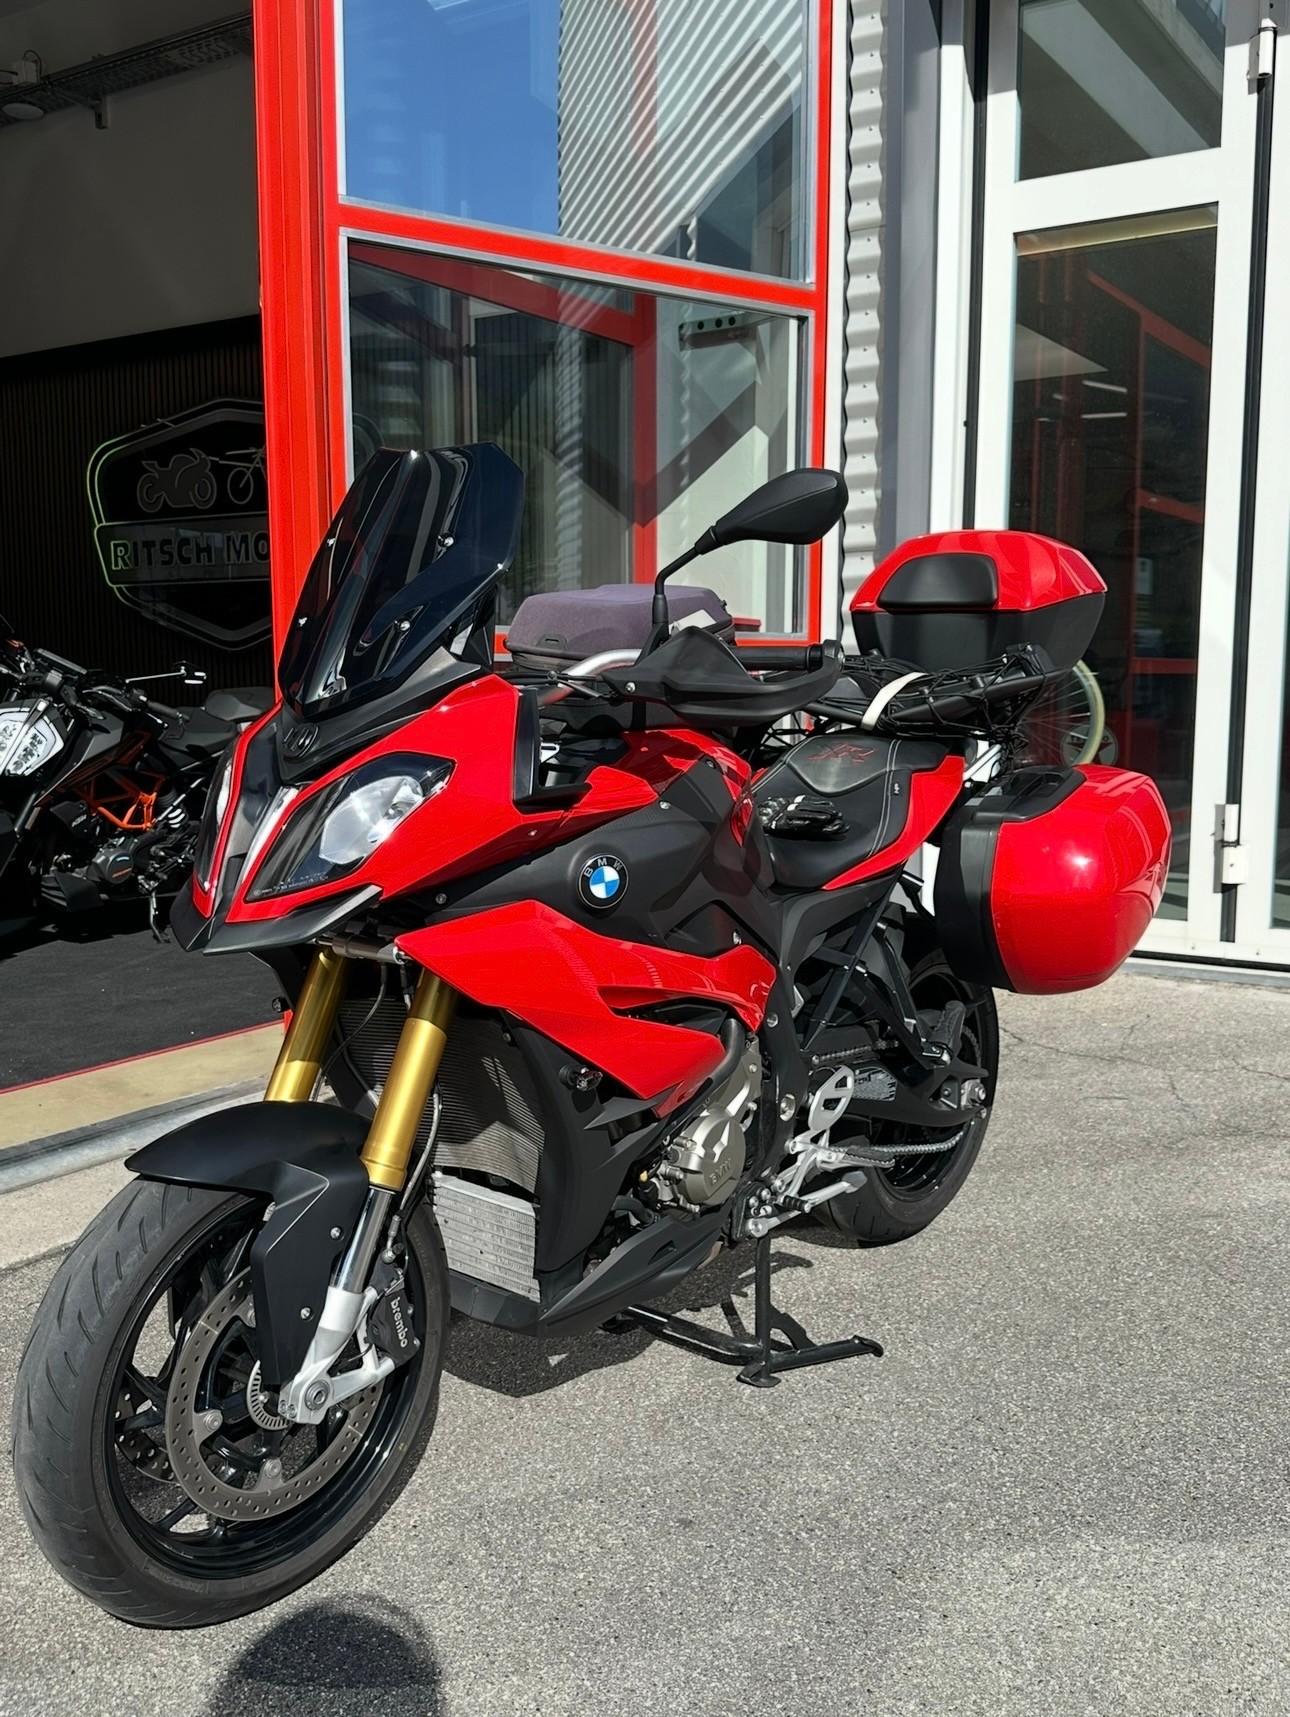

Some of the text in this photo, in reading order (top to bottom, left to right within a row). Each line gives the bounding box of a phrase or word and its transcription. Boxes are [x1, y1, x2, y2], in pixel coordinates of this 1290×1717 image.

[110, 535, 214, 571] RITSCH
[583, 857, 623, 878] BMW
[390, 1296, 408, 1348] brembo
